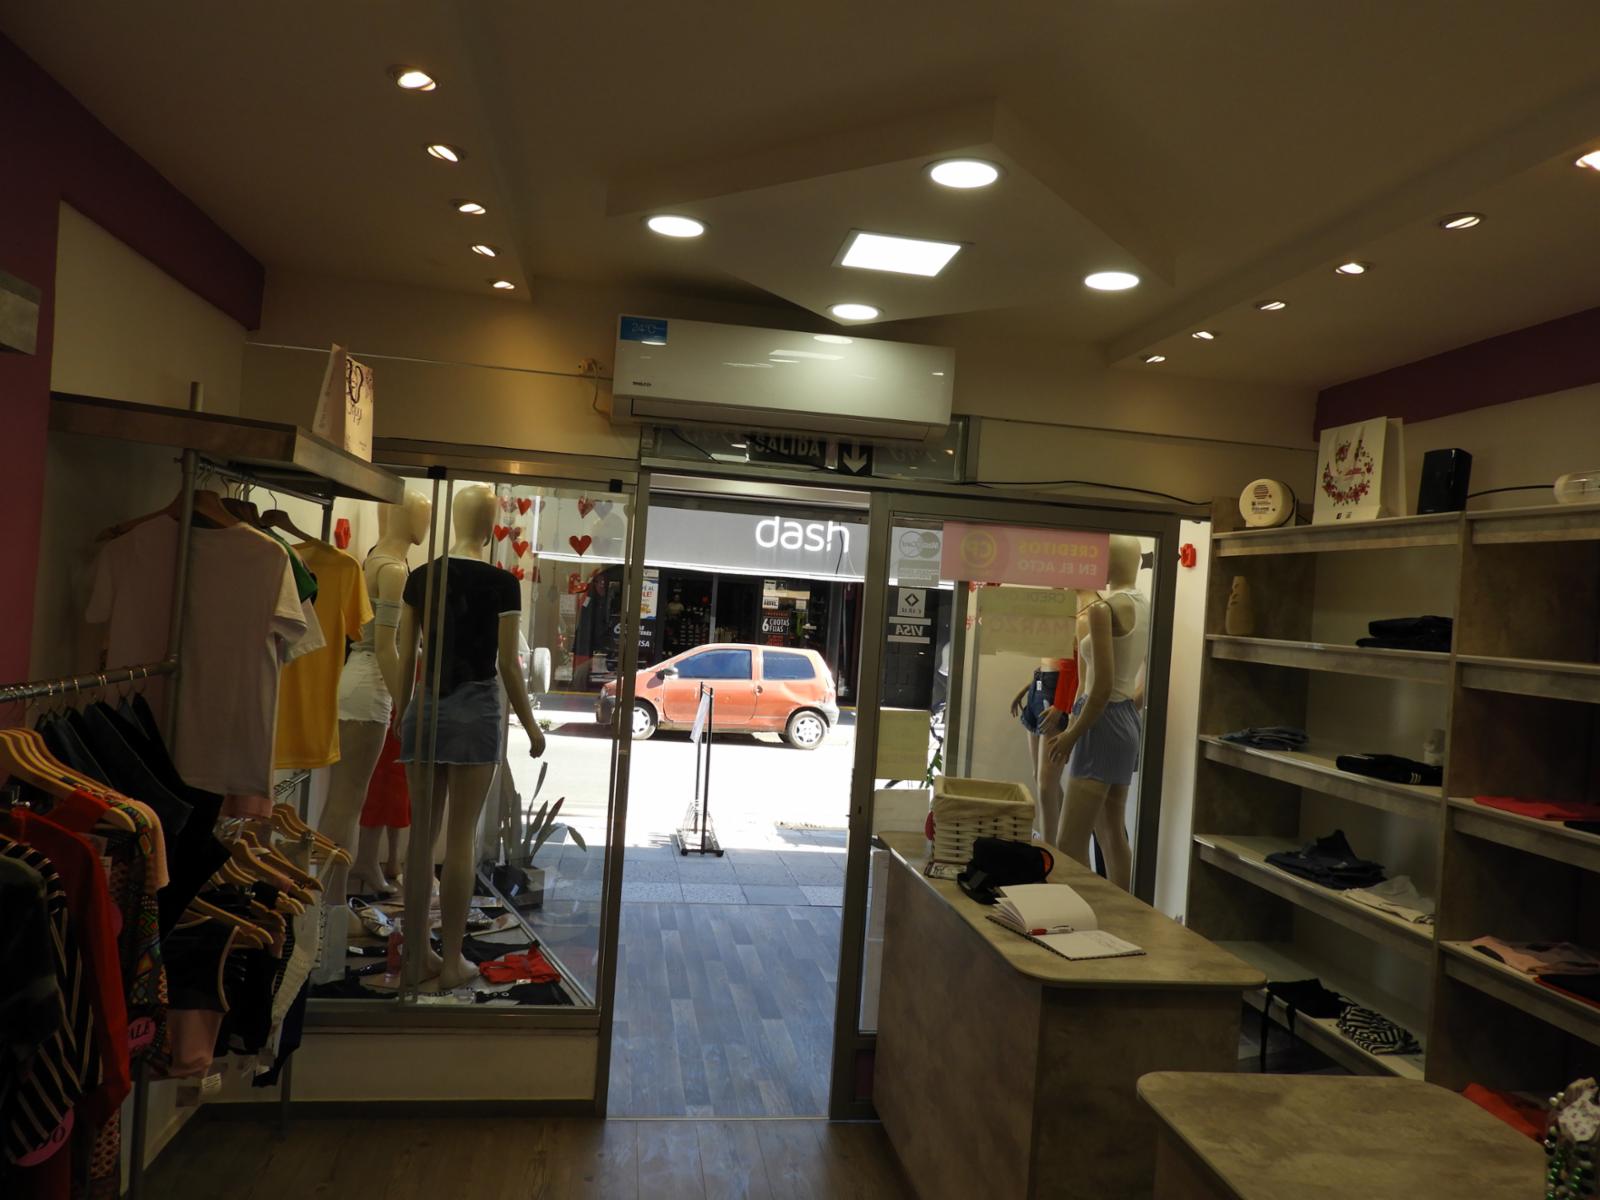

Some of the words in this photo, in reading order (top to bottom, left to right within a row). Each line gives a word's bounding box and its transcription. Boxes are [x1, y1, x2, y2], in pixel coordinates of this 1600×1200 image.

[754, 436, 821, 458] SALIDA
[755, 516, 850, 553] dash
[762, 617, 770, 632] 6
[769, 618, 790, 627] CUOTAS
